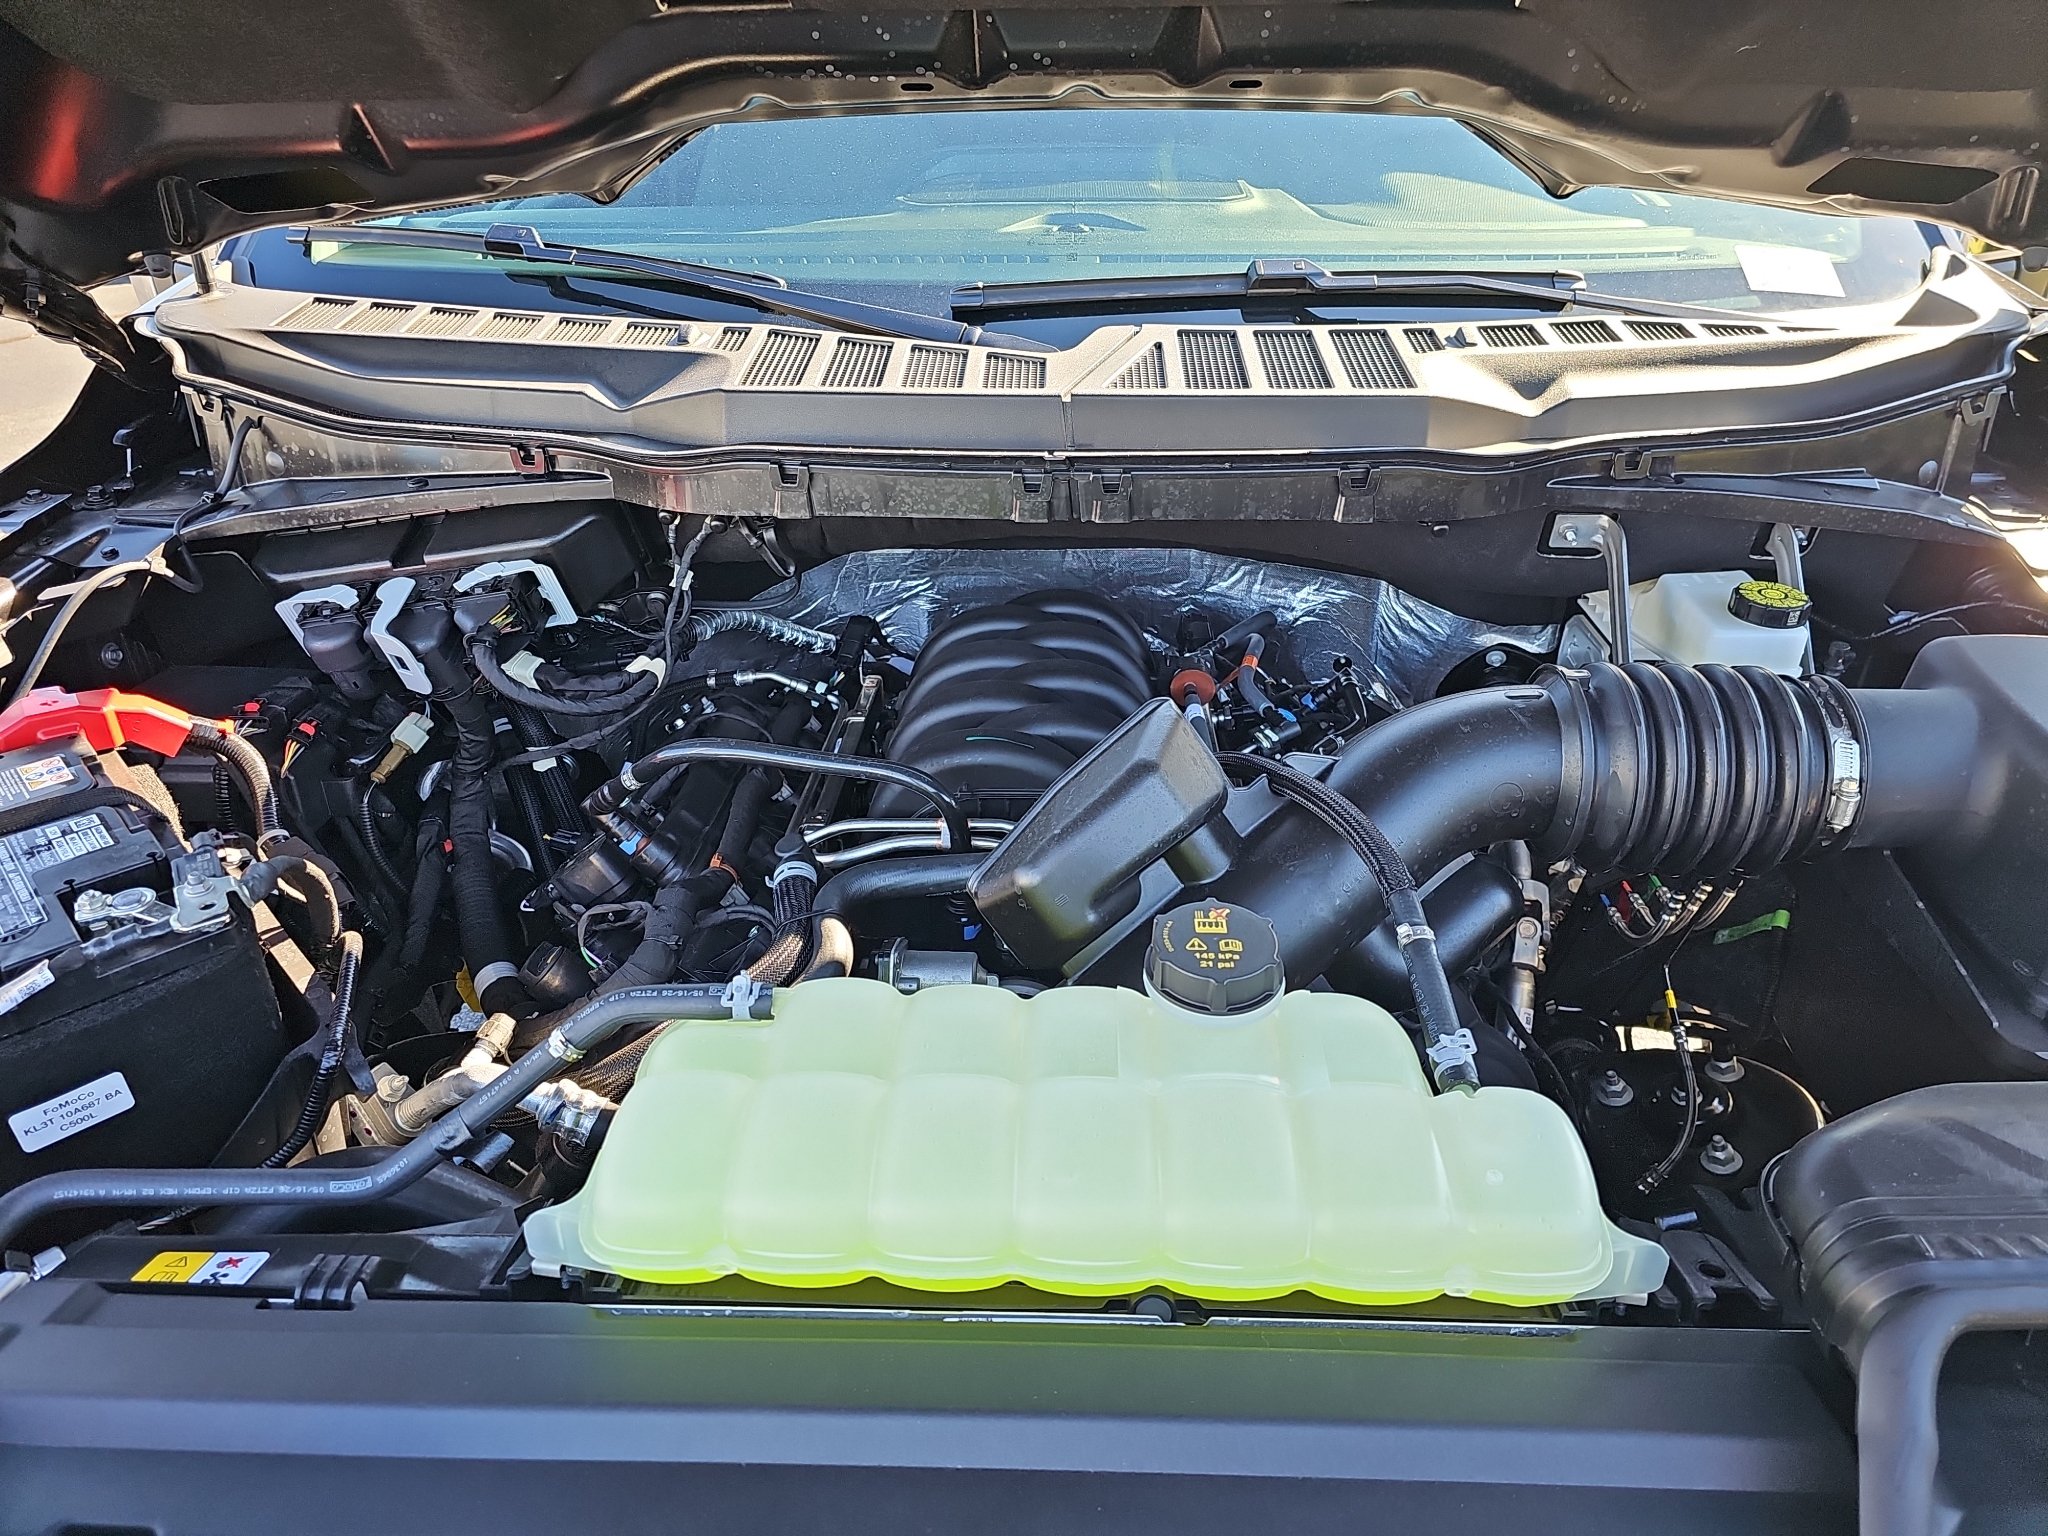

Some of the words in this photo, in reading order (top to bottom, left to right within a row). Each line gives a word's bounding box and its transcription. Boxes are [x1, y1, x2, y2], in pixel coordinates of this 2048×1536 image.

[1194, 952, 1215, 960] 145
[1218, 952, 1240, 960] kPa
[1217, 960, 1234, 969] psi
[661, 988, 704, 997] 05/16/26
[42, 1090, 95, 1116] FoMoCo
[23, 1117, 58, 1136] KL3T
[59, 1098, 102, 1121] 10A687
[104, 1089, 123, 1101] BA
[59, 1112, 98, 1132] C500L
